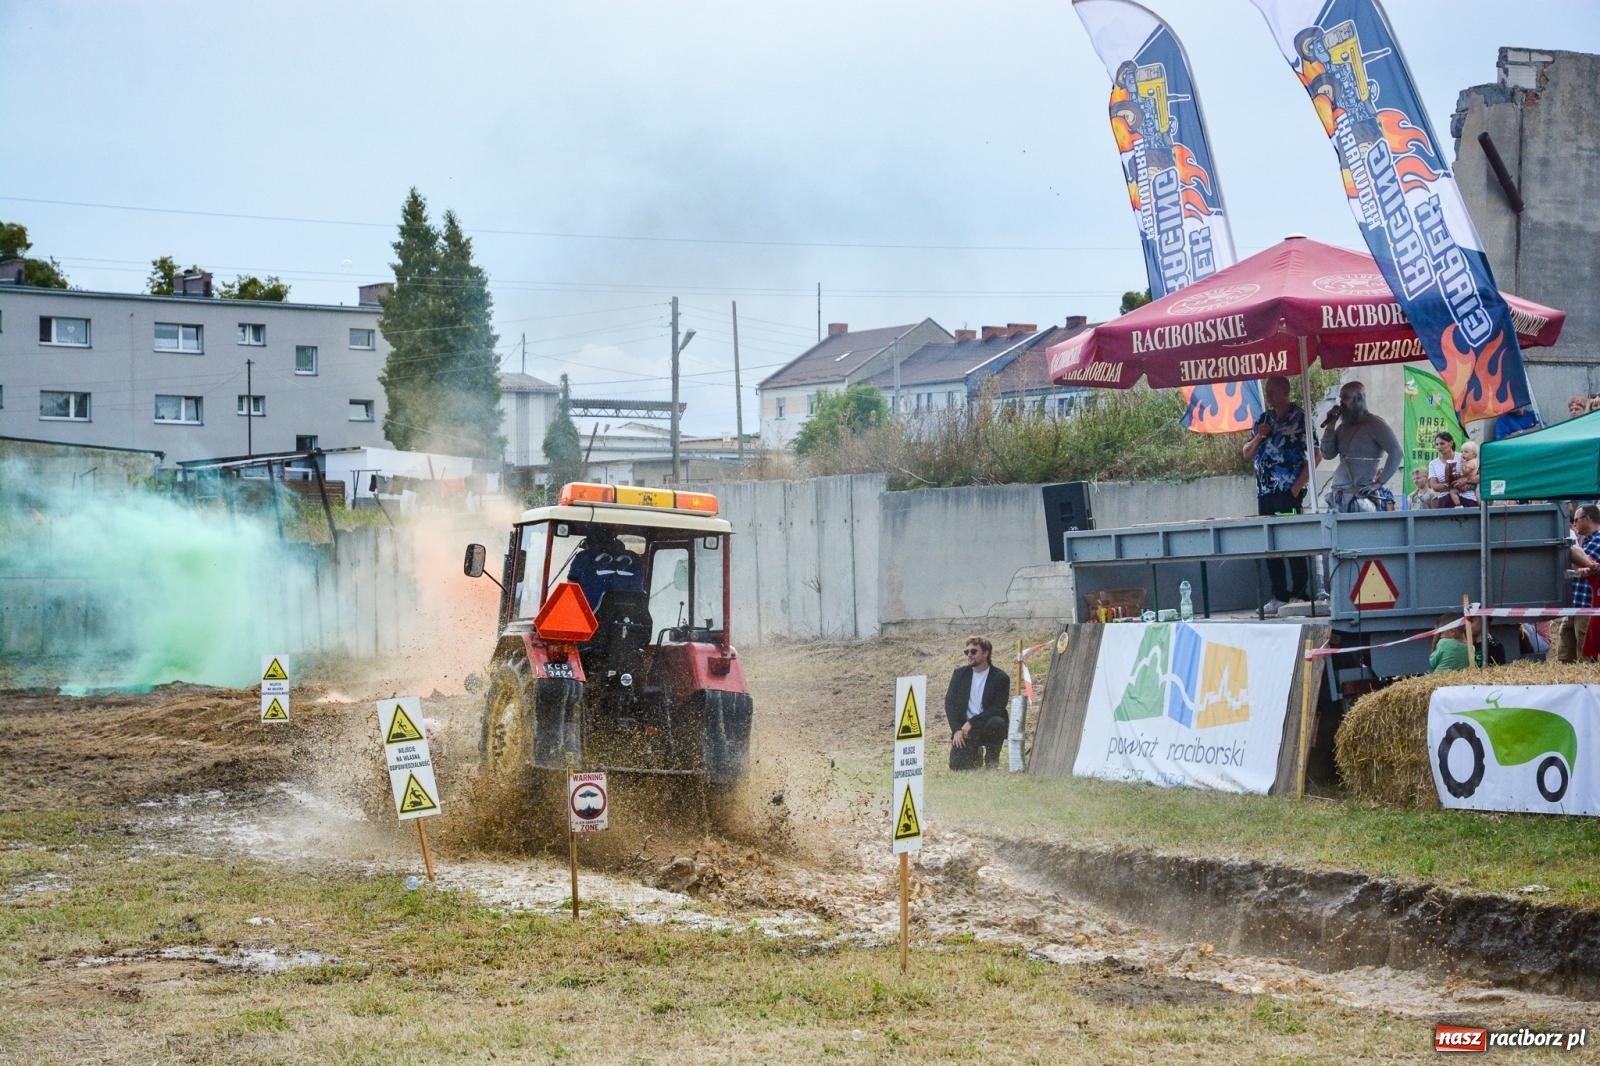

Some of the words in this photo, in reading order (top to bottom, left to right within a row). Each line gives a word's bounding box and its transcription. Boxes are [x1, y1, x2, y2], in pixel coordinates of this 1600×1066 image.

[1321, 302, 1409, 329] RACIBOR
[1132, 314, 1247, 353] RACIBORSKIE
[1106, 733, 1158, 762] powiat
[1166, 736, 1247, 767] raciborski
[573, 774, 603, 782] WARNING
